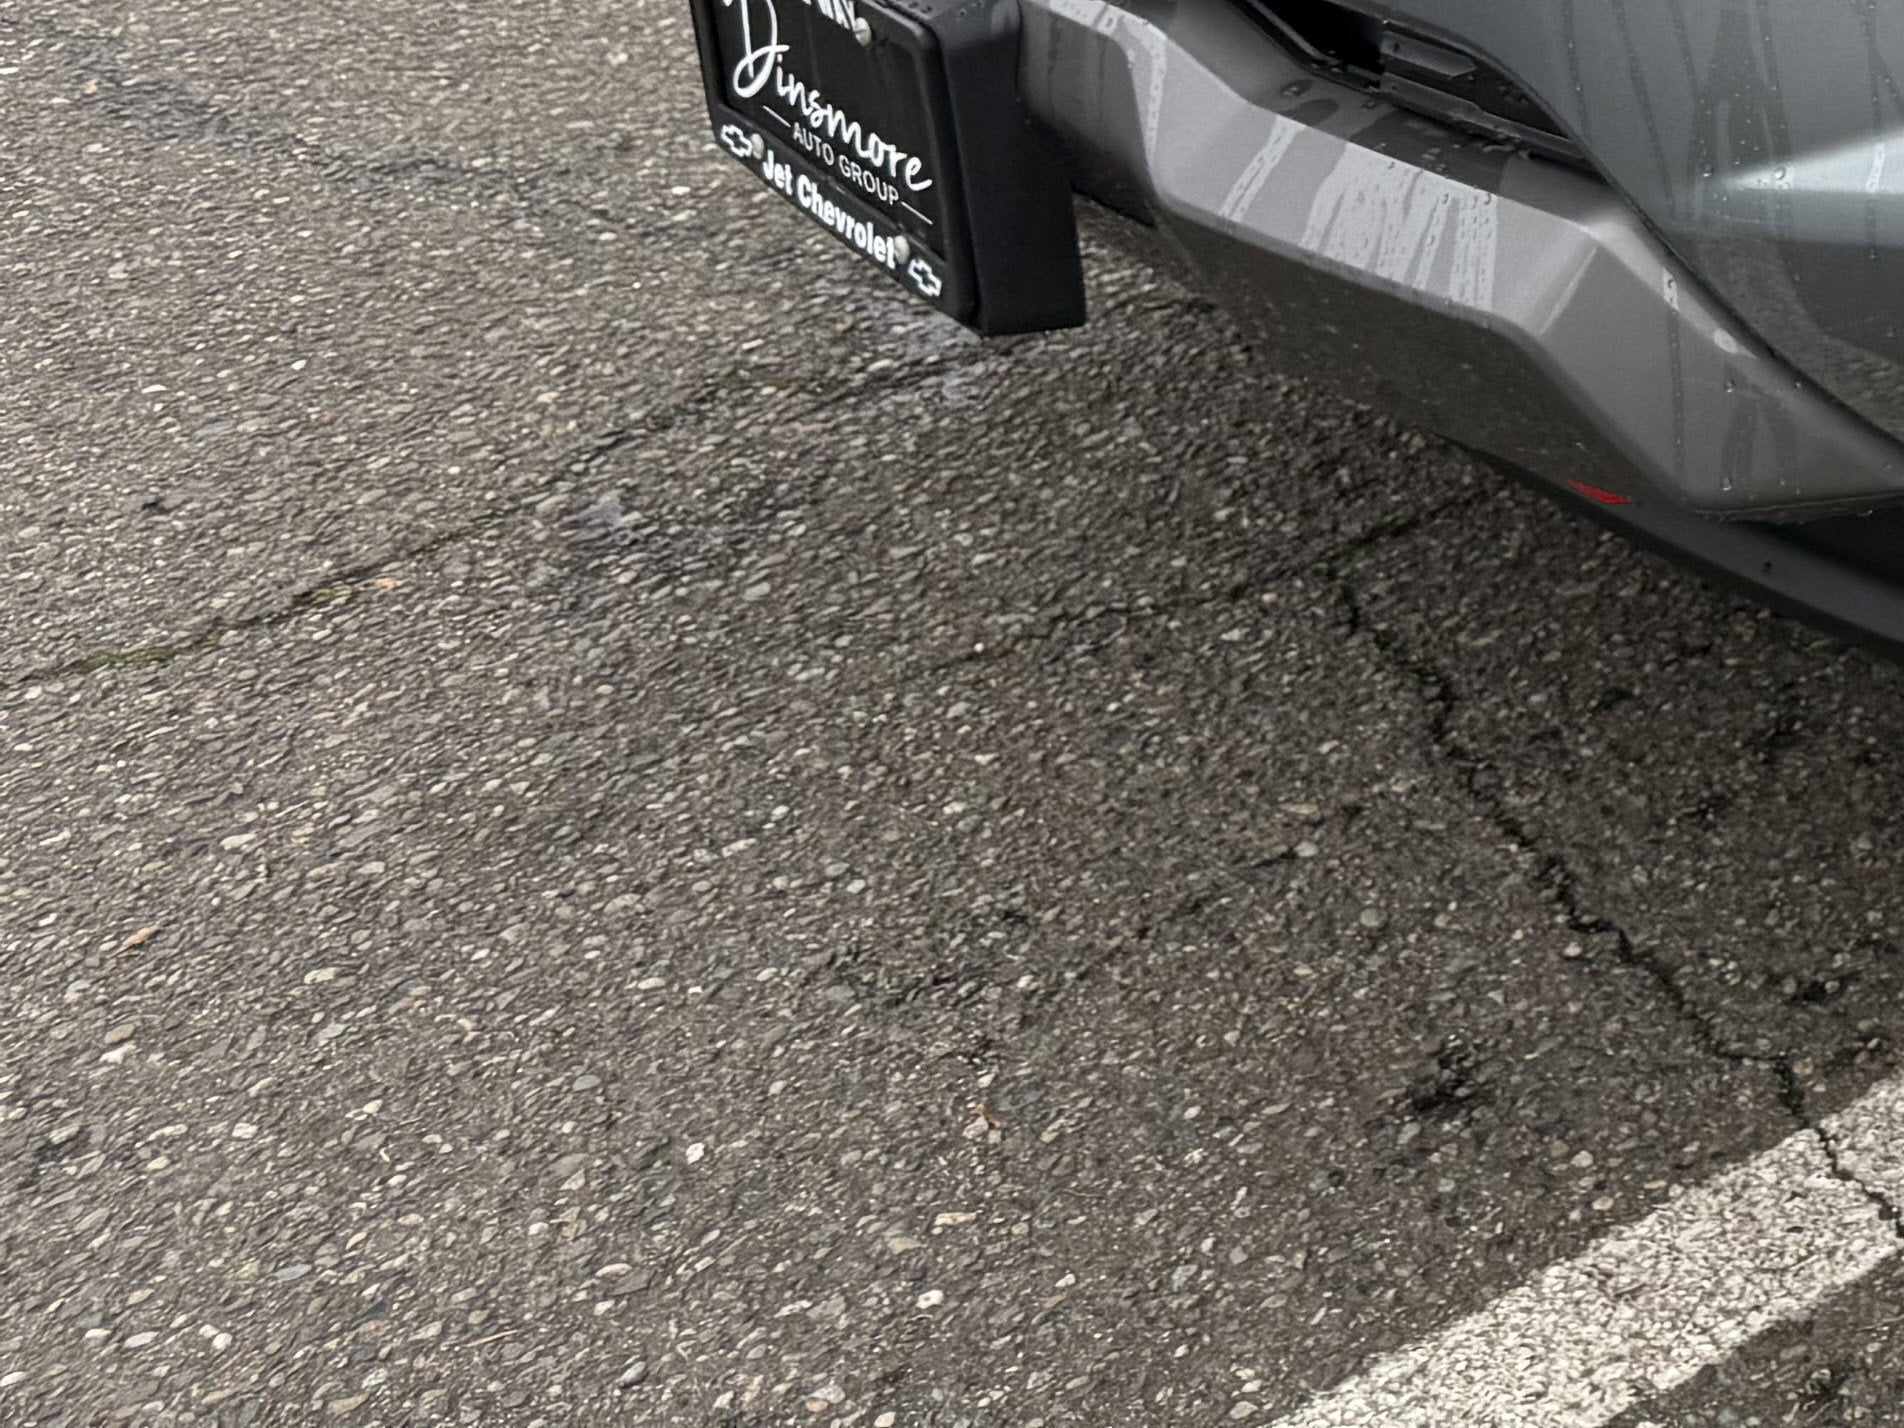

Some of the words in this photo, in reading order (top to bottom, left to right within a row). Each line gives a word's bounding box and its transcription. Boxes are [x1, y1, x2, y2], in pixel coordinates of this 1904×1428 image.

[762, 149, 793, 196] Jet
[796, 174, 896, 270] Chevrolet
[792, 121, 835, 166] AUTO
[838, 154, 900, 206] GROUP
